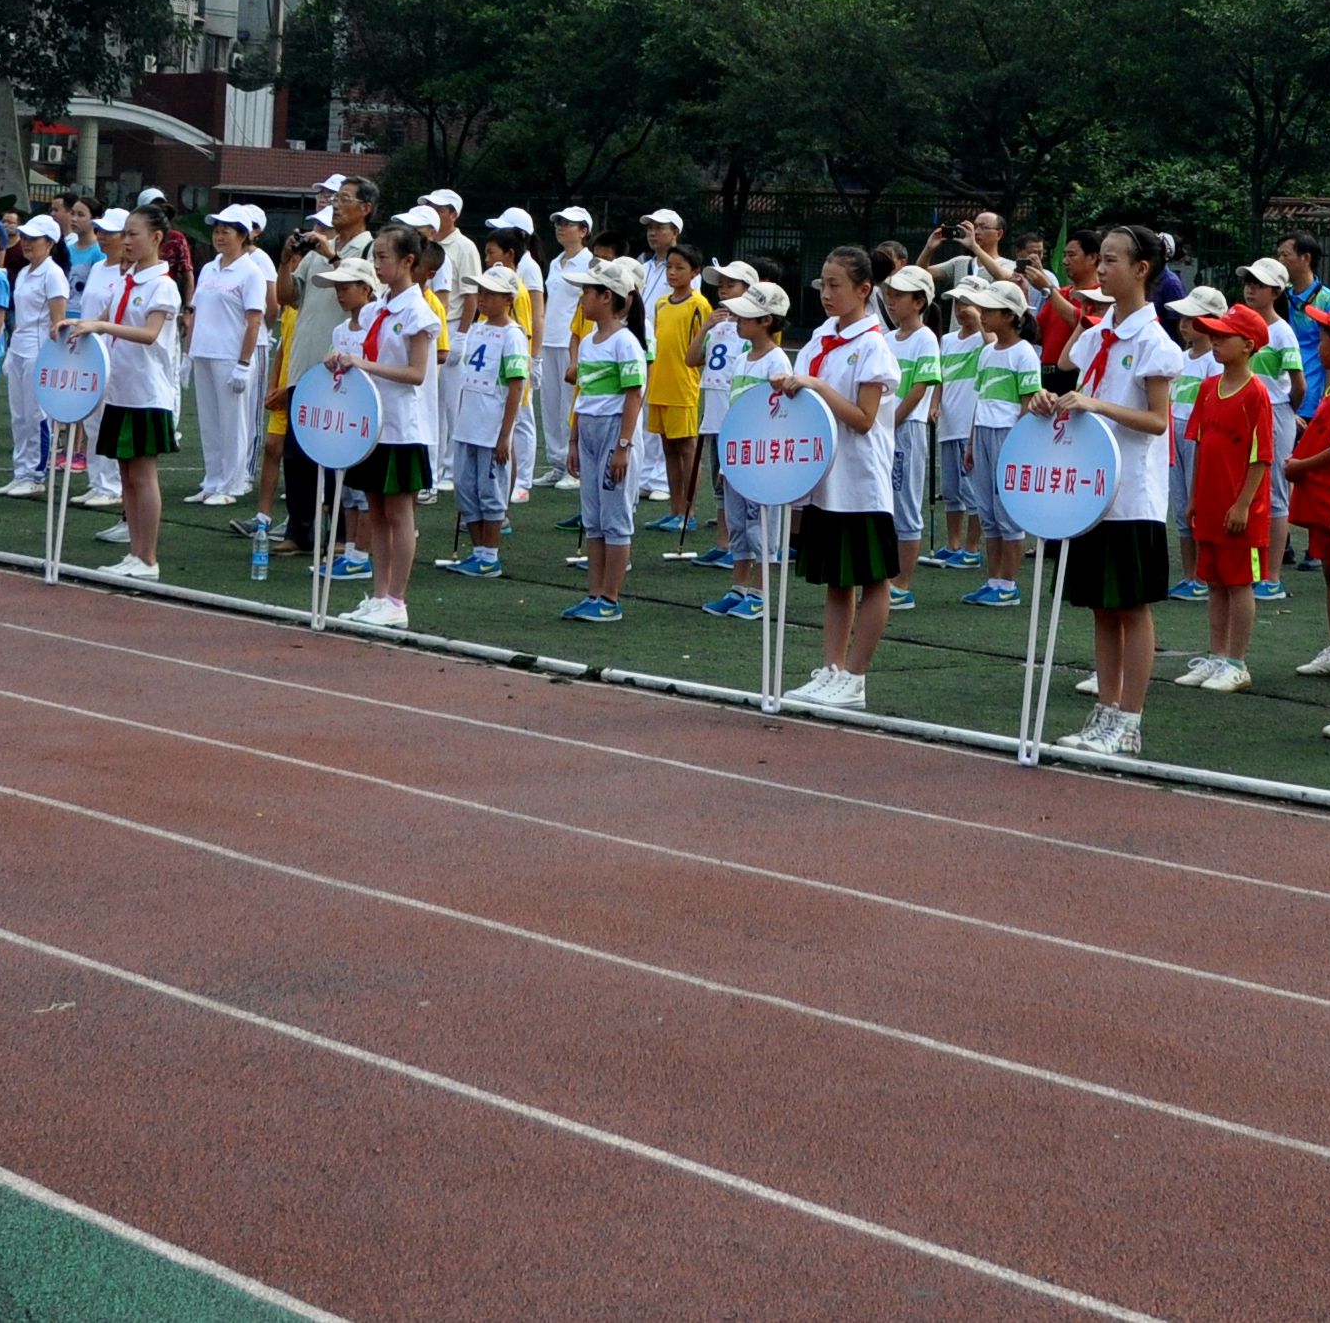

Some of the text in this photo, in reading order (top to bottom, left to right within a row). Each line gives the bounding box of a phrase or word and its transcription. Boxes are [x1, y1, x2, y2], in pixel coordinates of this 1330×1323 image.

[469, 344, 487, 372] 4
[708, 343, 728, 371] 8
[40, 367, 99, 393] 南川少儿二队
[297, 404, 370, 439] 南川少儿一队
[726, 437, 824, 466] 四面山学校二队
[1004, 464, 1105, 497] 四面山学校一队
